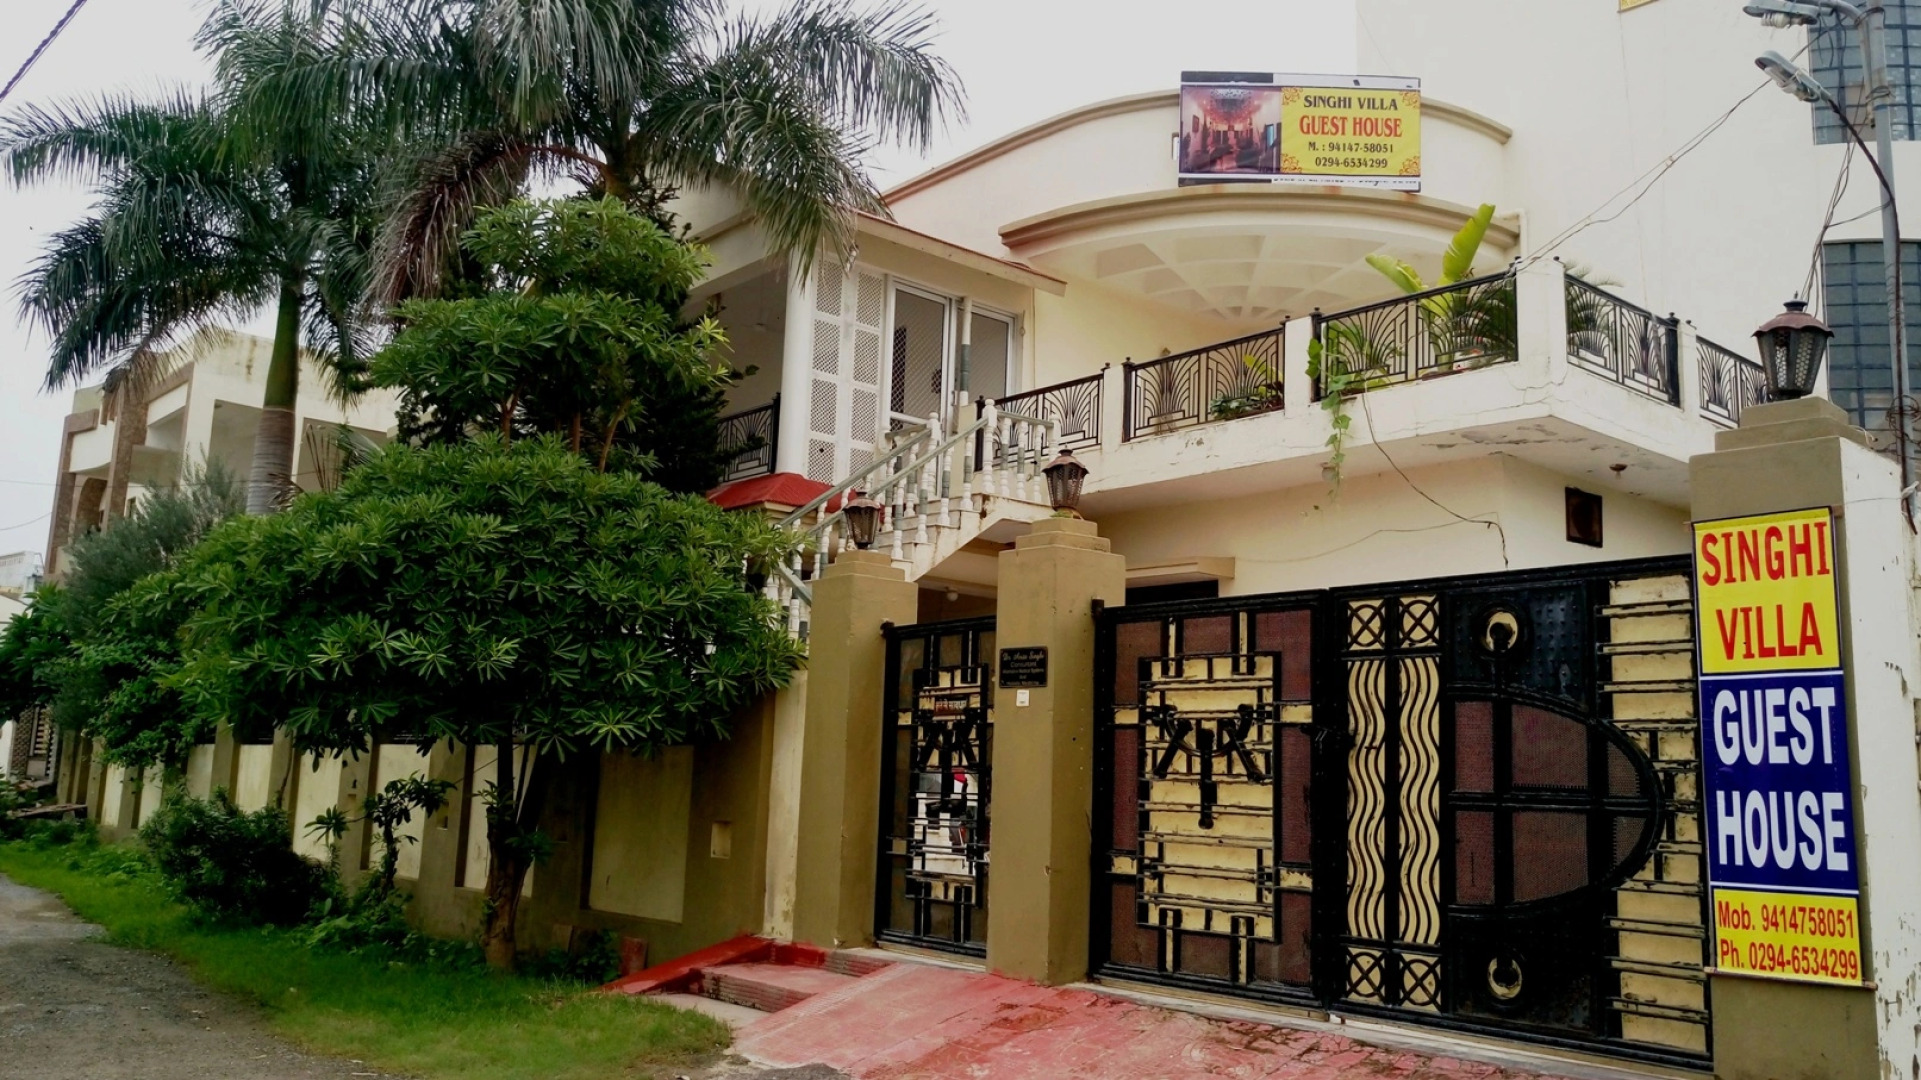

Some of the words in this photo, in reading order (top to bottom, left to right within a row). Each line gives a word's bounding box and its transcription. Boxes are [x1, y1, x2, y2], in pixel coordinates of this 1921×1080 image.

[1303, 95, 1352, 109] SINGHI
[1357, 97, 1398, 111] VILLA
[1299, 115, 1347, 136] GUEST
[1352, 117, 1402, 137] HOUSE
[1315, 156, 1388, 168] 0294-6534299
[1328, 142, 1393, 153] 94147-58051
[1701, 521, 1830, 586] SINGHI
[1715, 602, 1823, 661] VILLA
[1713, 687, 1836, 766] GUEST
[1716, 790, 1849, 871] HOUSE
[1718, 900, 1756, 930] Mob.
[1761, 904, 1854, 938] 9414758051
[1720, 938, 1745, 968] Ph.
[1749, 942, 1858, 980] 0294-6534299
